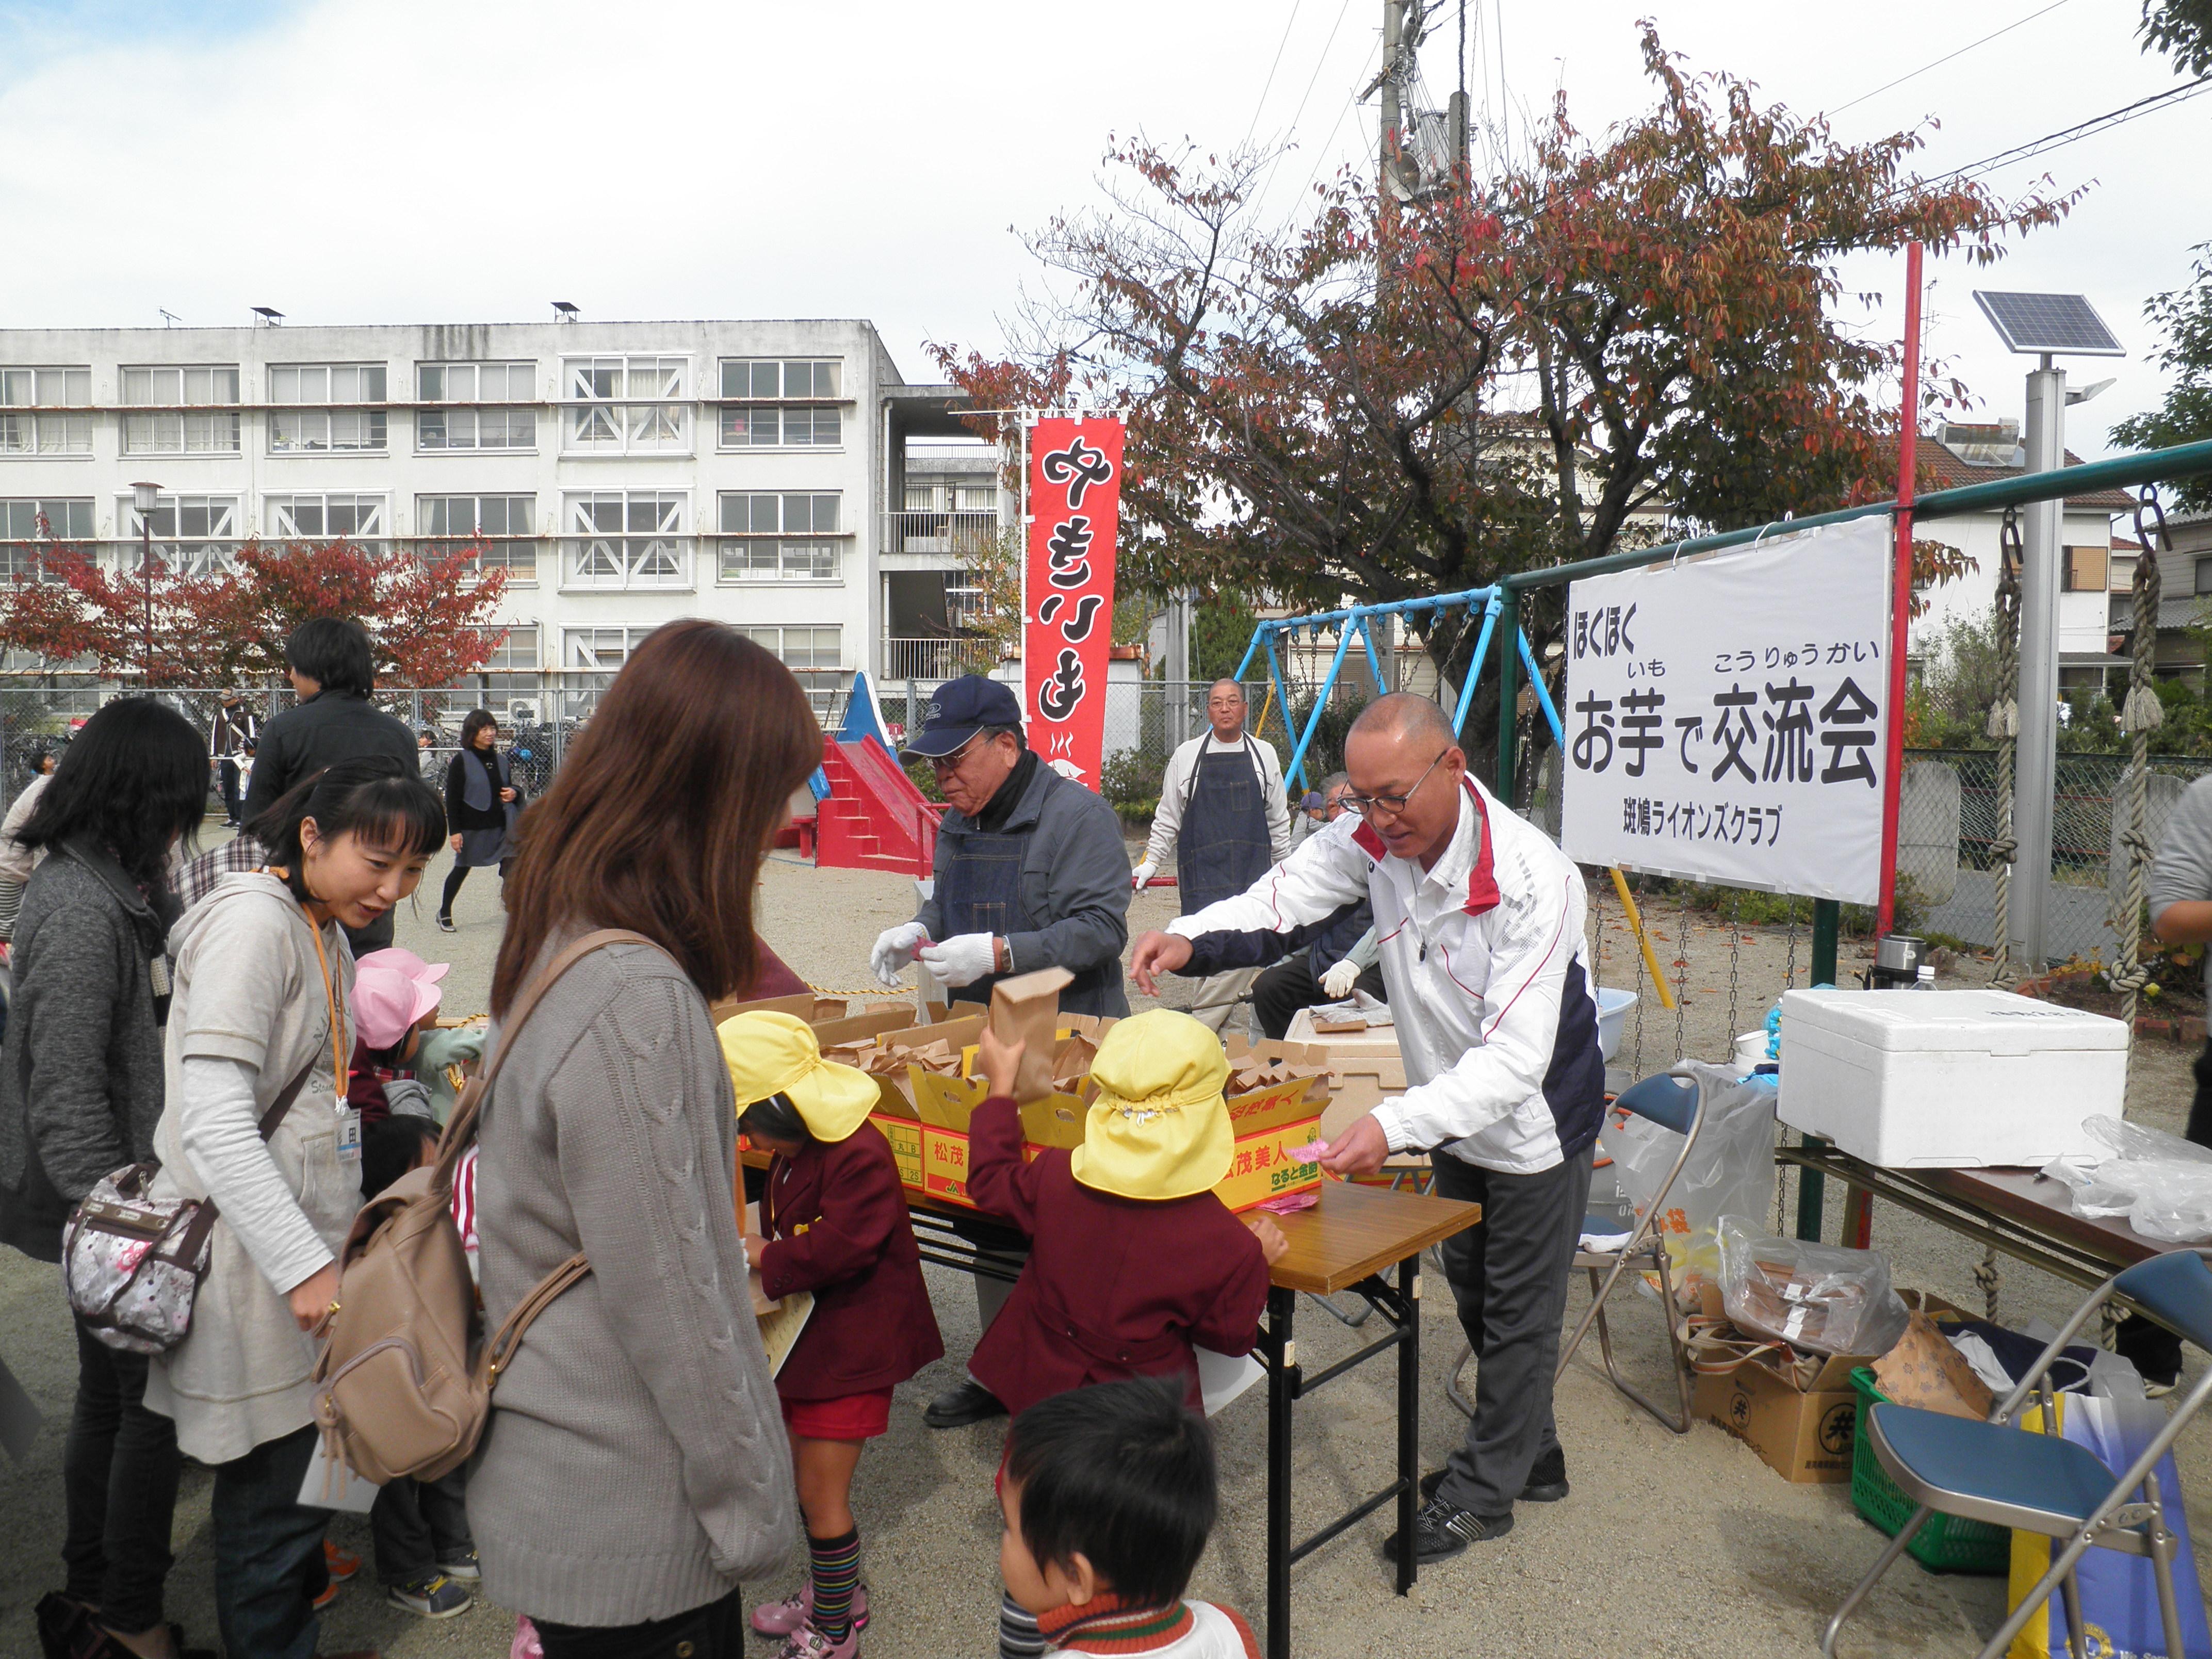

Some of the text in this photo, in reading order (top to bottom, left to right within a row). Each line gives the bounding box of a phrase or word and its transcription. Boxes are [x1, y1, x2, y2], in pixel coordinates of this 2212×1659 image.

[1039, 436, 1113, 722] やきいも
[1573, 602, 1637, 660] ほくほく
[1628, 641, 1879, 678] いも こうりゅうかい
[1572, 676, 1878, 788] お芋で交流会
[1623, 796, 1783, 848] 斑鳩ライオンズクラブ
[911, 1145, 916, 1153] B
[910, 1171, 919, 1180] 2S
